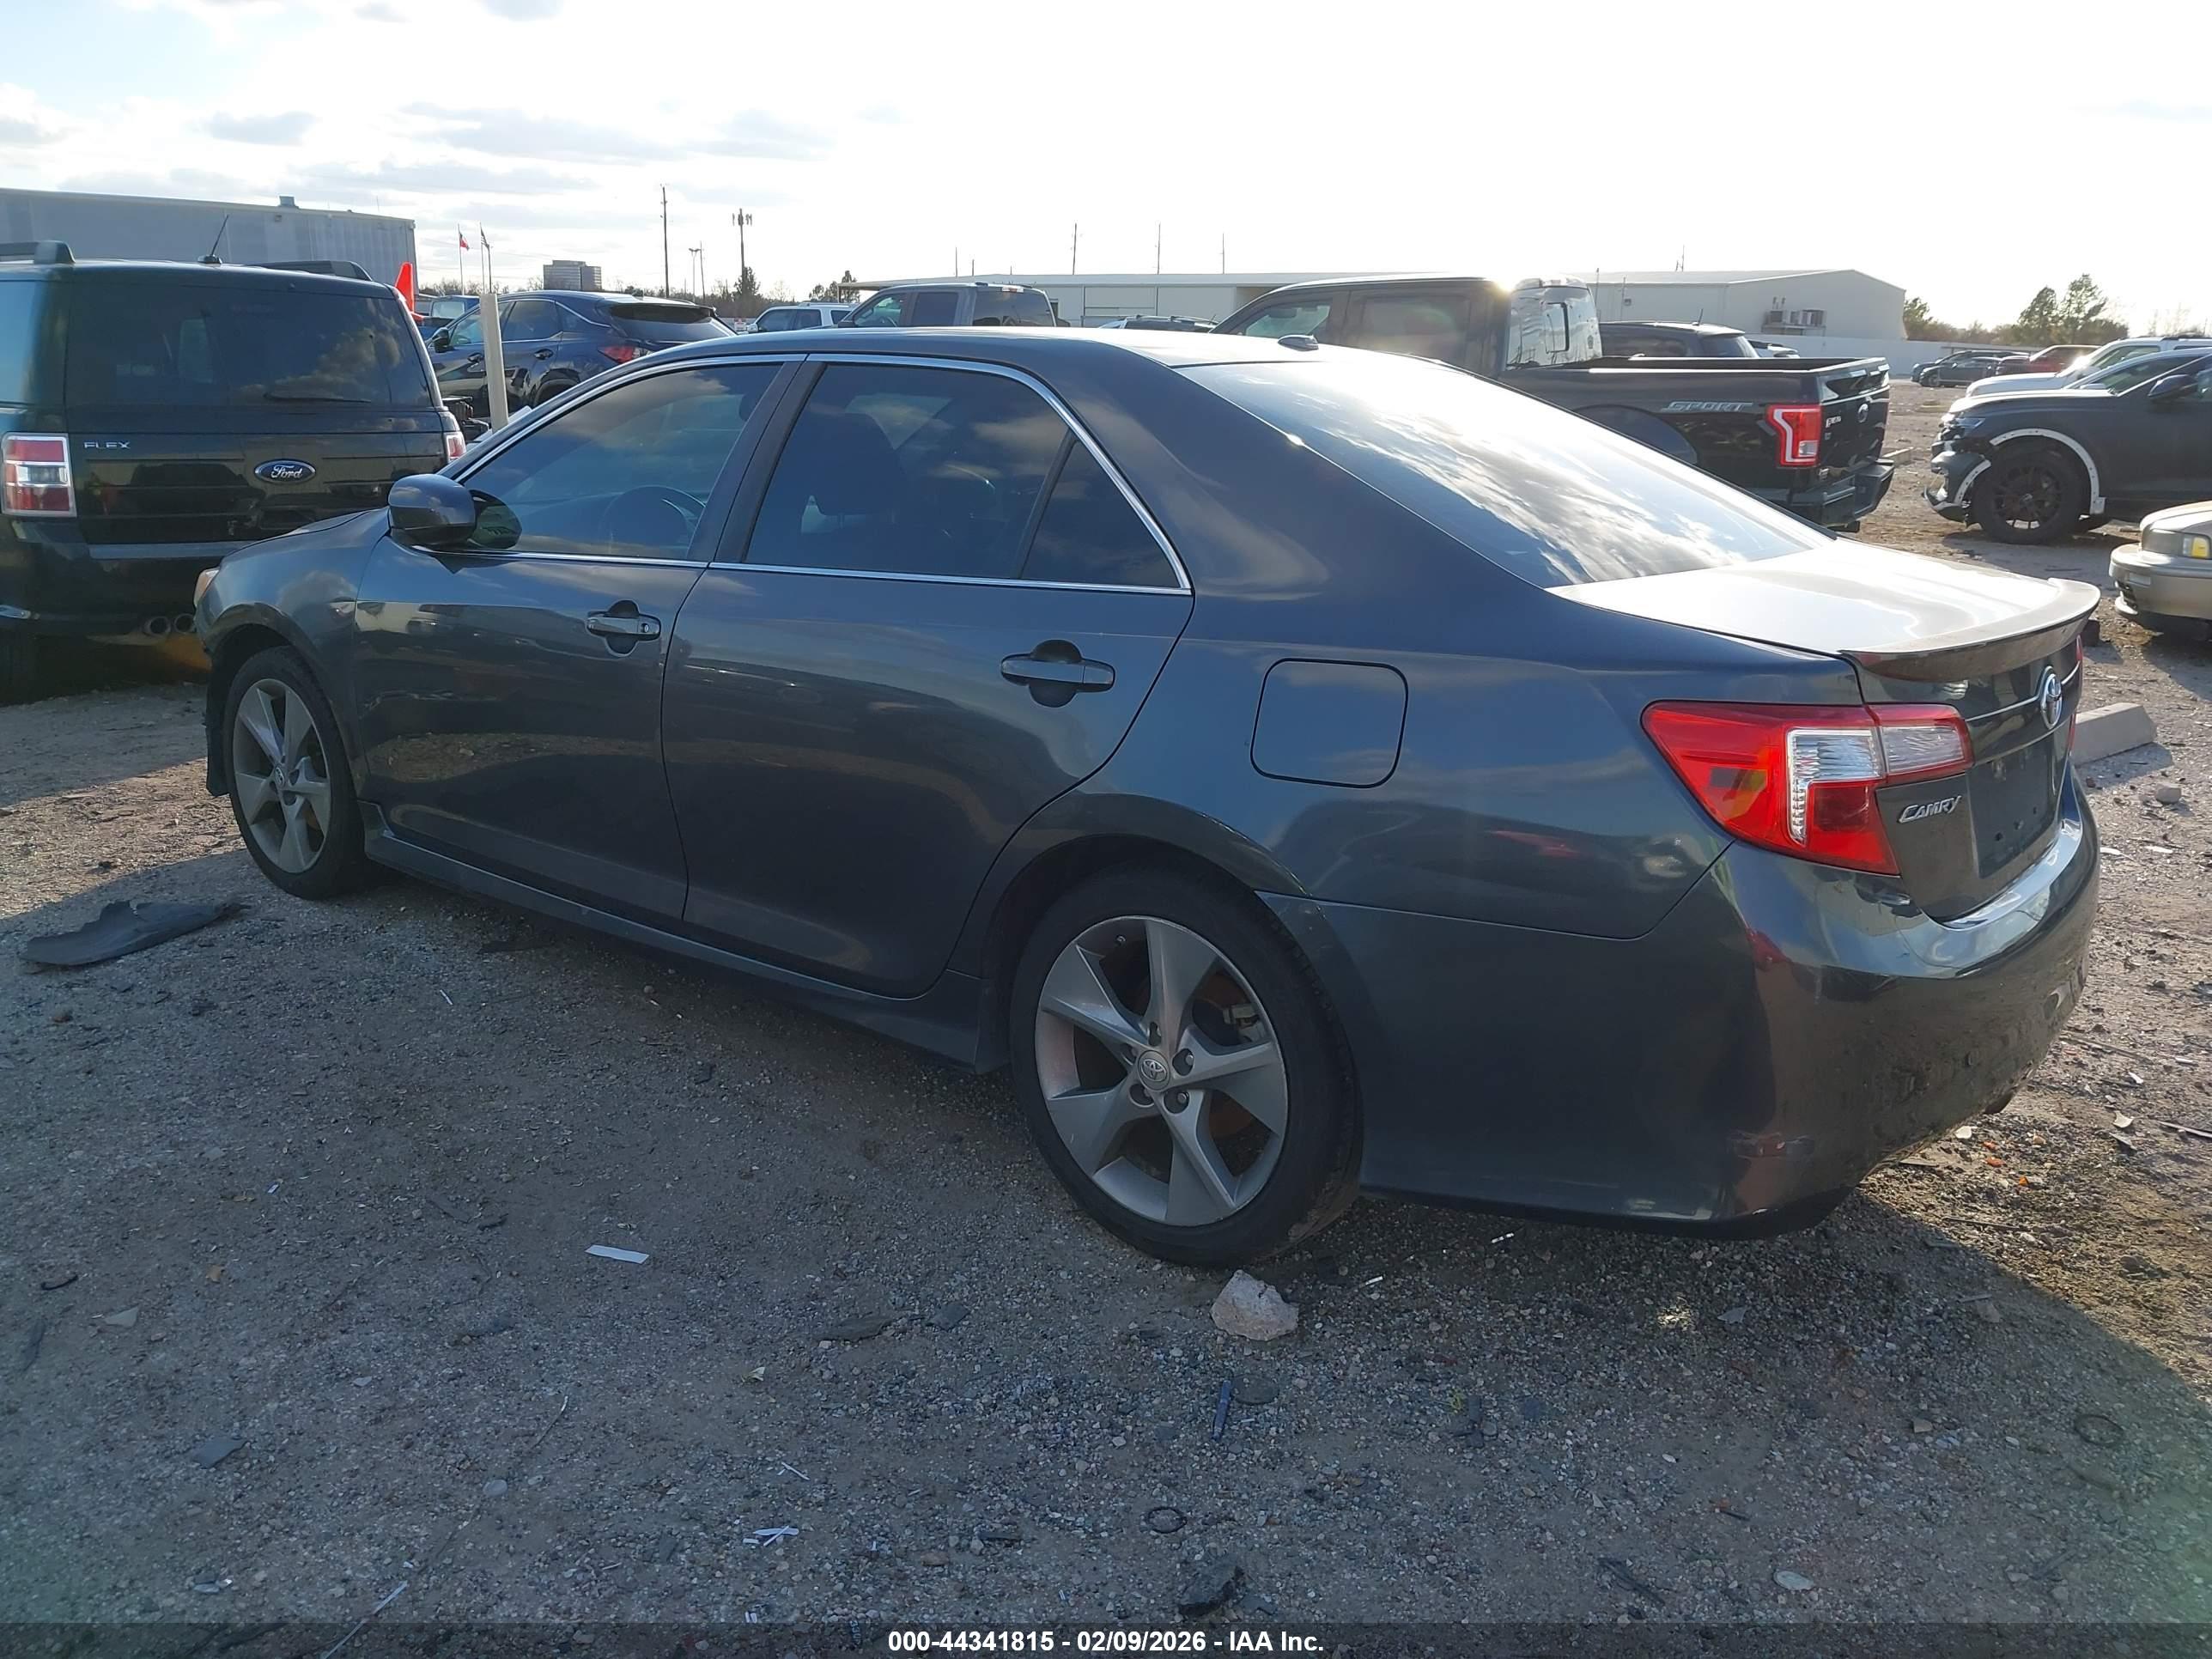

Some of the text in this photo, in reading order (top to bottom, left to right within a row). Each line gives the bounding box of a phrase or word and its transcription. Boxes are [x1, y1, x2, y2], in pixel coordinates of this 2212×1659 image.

[1661, 401, 1753, 413] SPORT
[83, 441, 131, 450] FLEX
[270, 465, 303, 478] Ford
[1899, 795, 1962, 823] CAMRY
